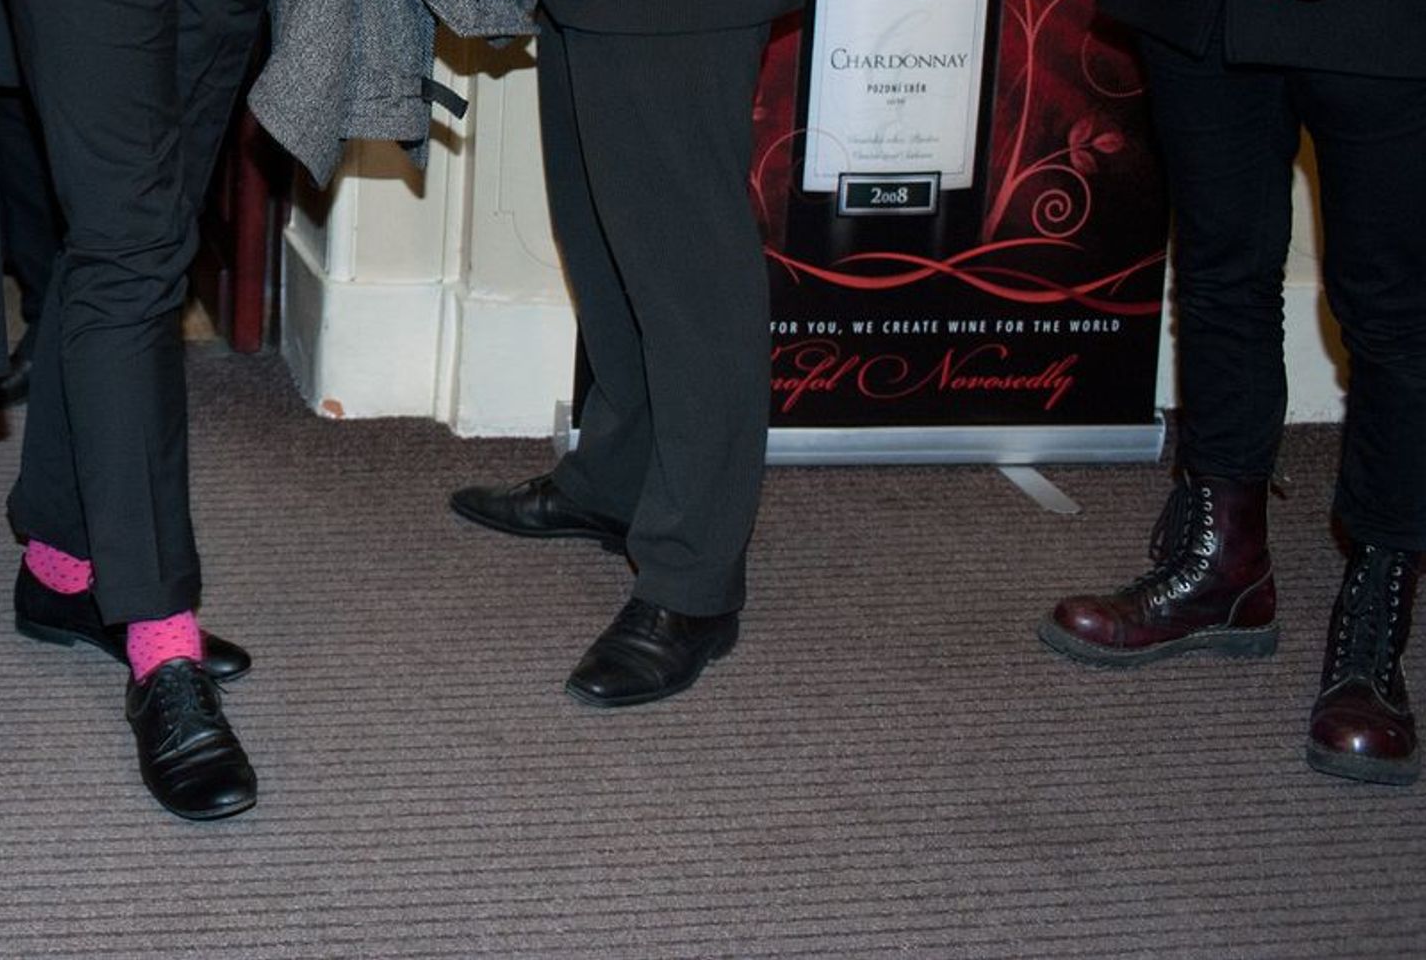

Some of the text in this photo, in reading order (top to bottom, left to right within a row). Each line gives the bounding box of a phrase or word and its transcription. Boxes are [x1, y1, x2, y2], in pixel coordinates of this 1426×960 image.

[830, 47, 968, 70] CHARDONNAY
[870, 187, 908, 204] 2008
[769, 319, 1121, 336] FOR YOU, WE CREATE WINE FOR THE WORLD
[858, 343, 1079, 410] Novosedly
